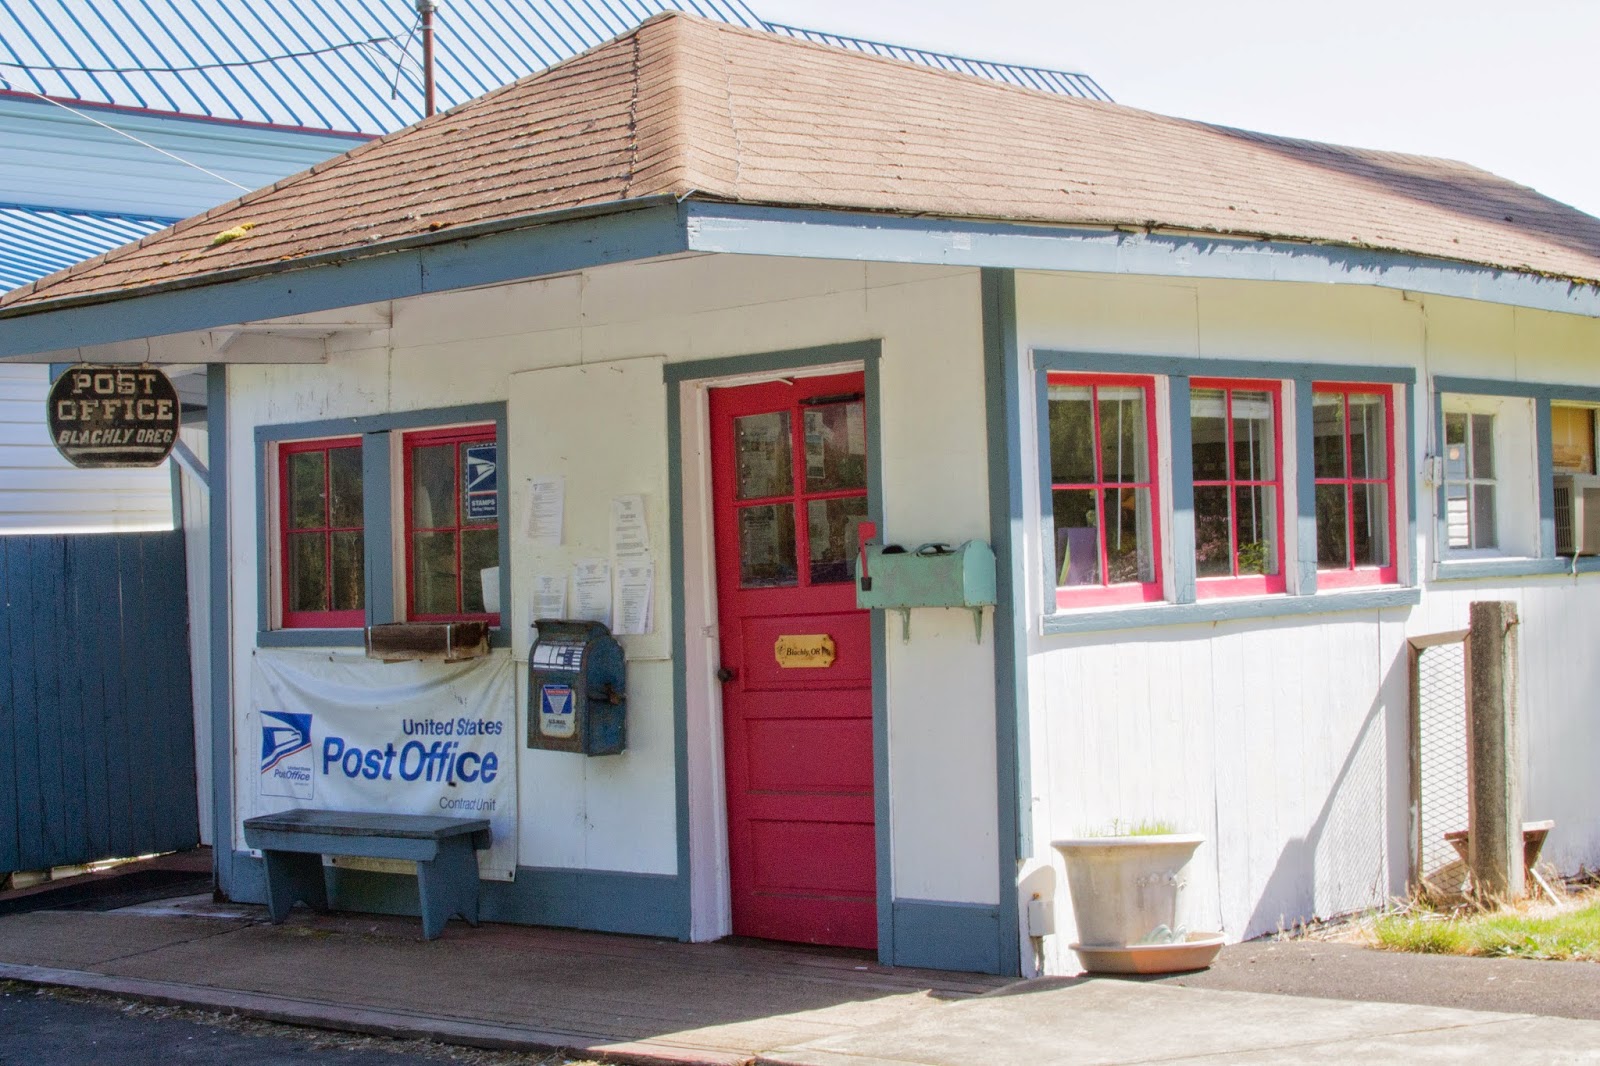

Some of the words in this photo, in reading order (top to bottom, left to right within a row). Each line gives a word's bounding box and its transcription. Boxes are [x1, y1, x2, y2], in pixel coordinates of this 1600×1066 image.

[71, 373, 157, 394] POST
[57, 399, 173, 421] OFFICE
[58, 428, 134, 444] BLACHLY
[471, 499, 496, 507] STAMPS
[402, 718, 454, 736] United
[456, 717, 503, 736] States
[322, 736, 397, 780] Post
[399, 740, 499, 784] Office
[439, 796, 477, 810] Contract
[476, 798, 497, 811] Unit
